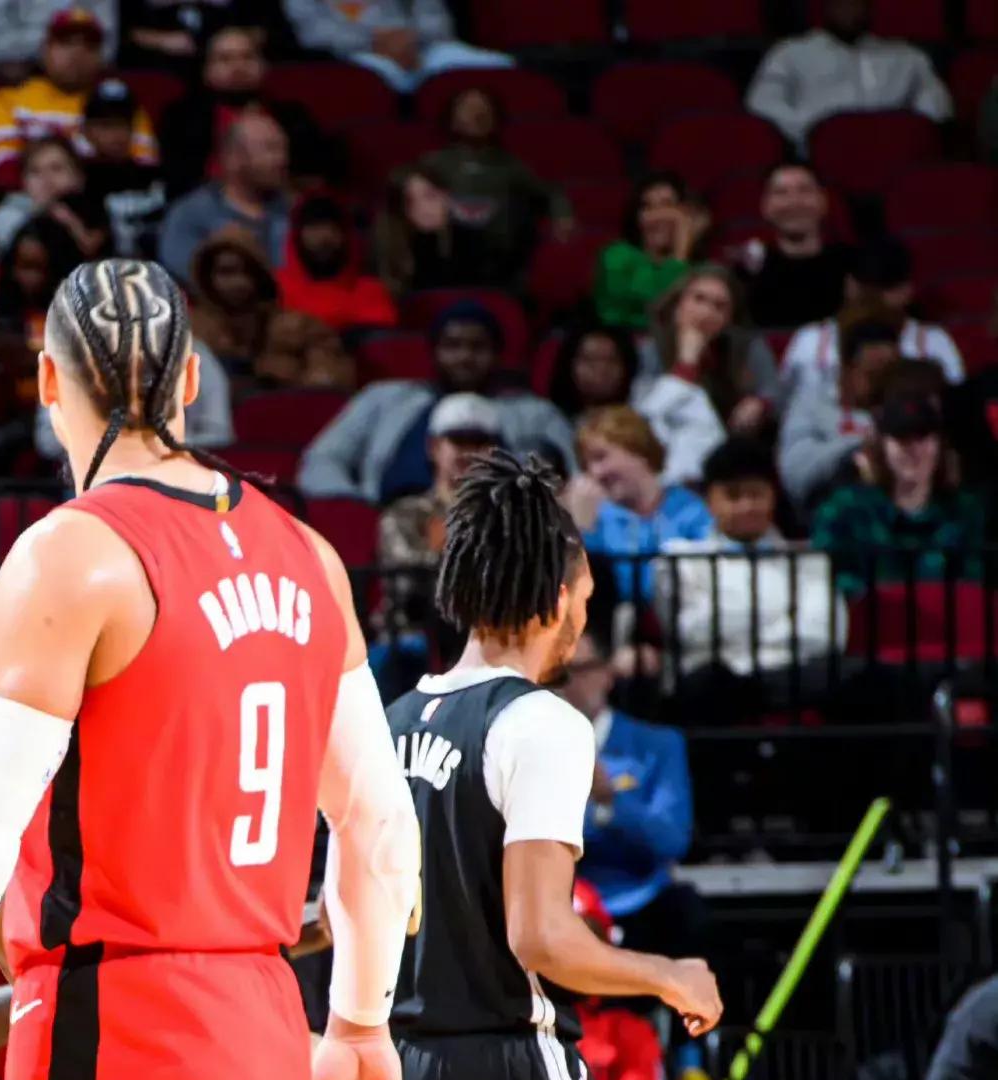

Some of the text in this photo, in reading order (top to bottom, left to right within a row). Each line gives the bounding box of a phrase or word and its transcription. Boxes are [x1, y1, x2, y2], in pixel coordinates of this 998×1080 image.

[199, 573, 311, 651] BROOKS
[230, 681, 285, 866] 9
[397, 731, 462, 790] LIAMS
